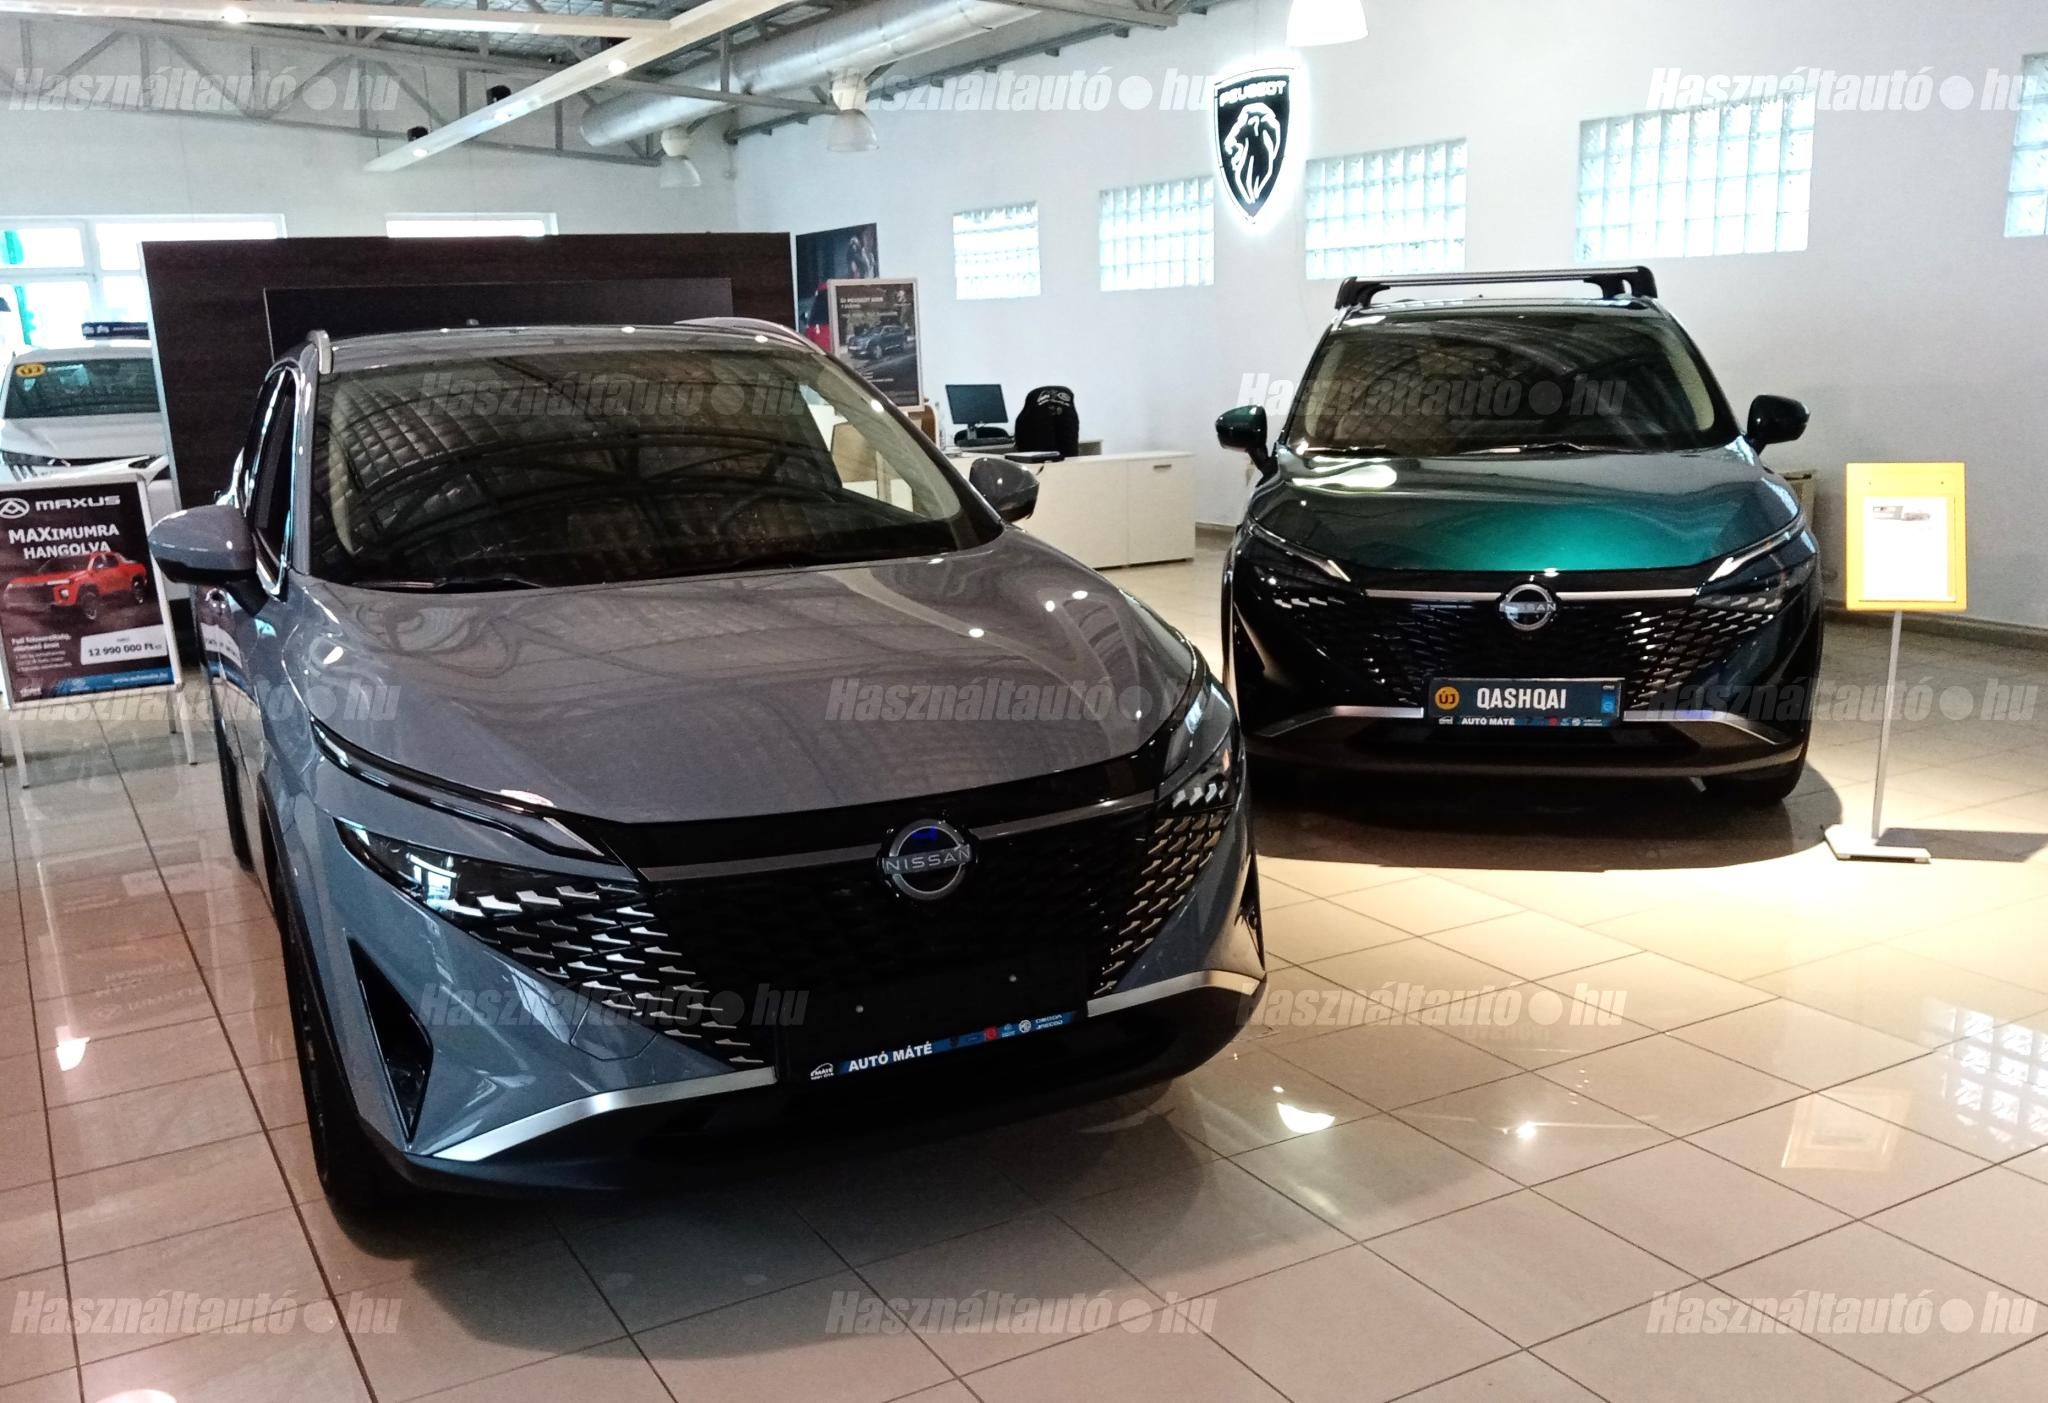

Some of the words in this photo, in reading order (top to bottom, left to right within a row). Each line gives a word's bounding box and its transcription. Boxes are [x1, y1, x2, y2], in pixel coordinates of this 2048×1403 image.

[1219, 80, 1287, 107] PEUGEOT
[35, 496, 120, 511] MAXUS
[23, 541, 111, 560] HANGOLVA
[1476, 687, 1567, 710] QASHQAI
[1461, 716, 1487, 726] AUTÓ
[1488, 716, 1515, 726] MÁTÉ
[886, 845, 971, 871] NISSAN
[848, 1051, 889, 1072] AUTÓ
[892, 1041, 933, 1061] MÁTÉ
